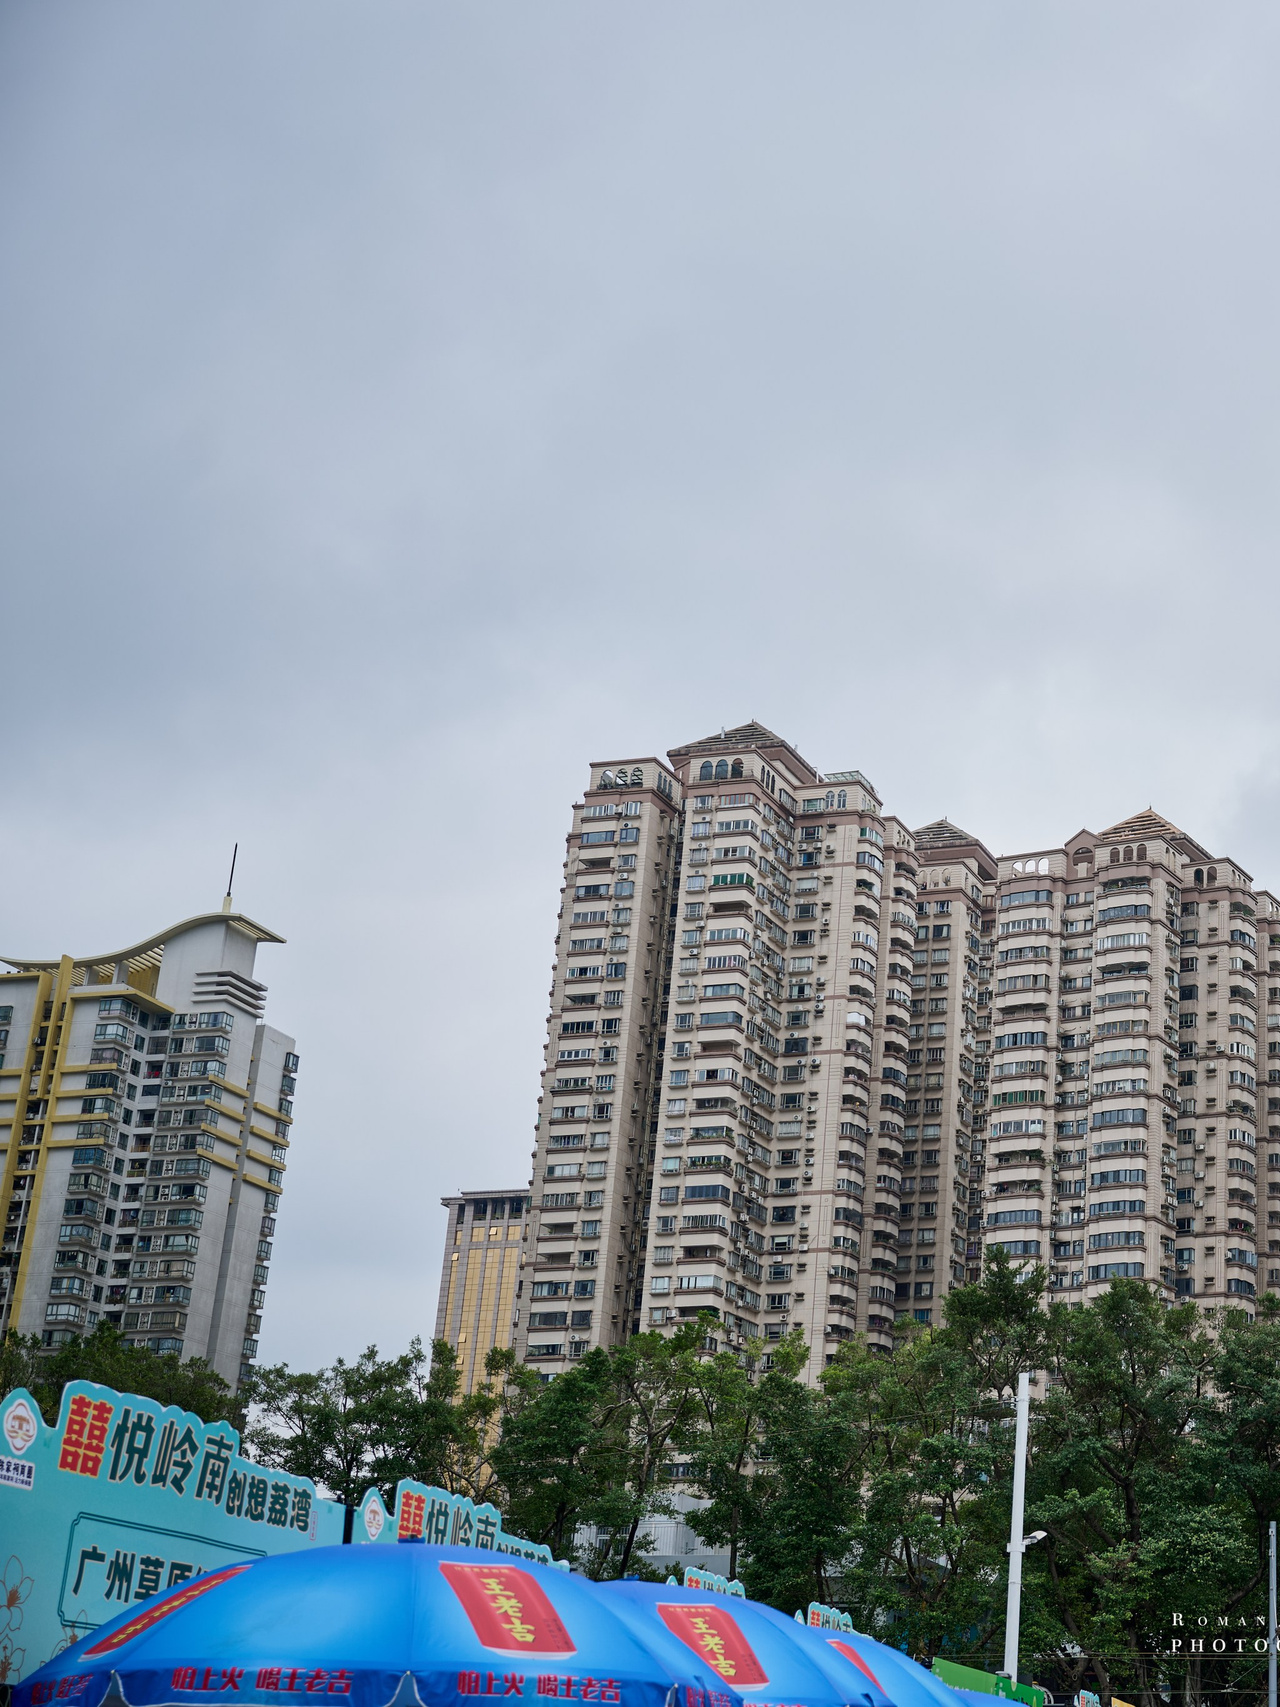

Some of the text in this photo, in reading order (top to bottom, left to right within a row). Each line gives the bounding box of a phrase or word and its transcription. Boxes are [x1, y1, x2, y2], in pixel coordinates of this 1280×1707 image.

[72, 1545, 210, 1604] 广州草原
[480, 1577, 536, 1643] 王老吉
[689, 1616, 738, 1676] 王老吉
[171, 1666, 354, 1695] 怕上火 喝王老吉
[457, 1670, 622, 1704] 怕上火 喝王老吉
